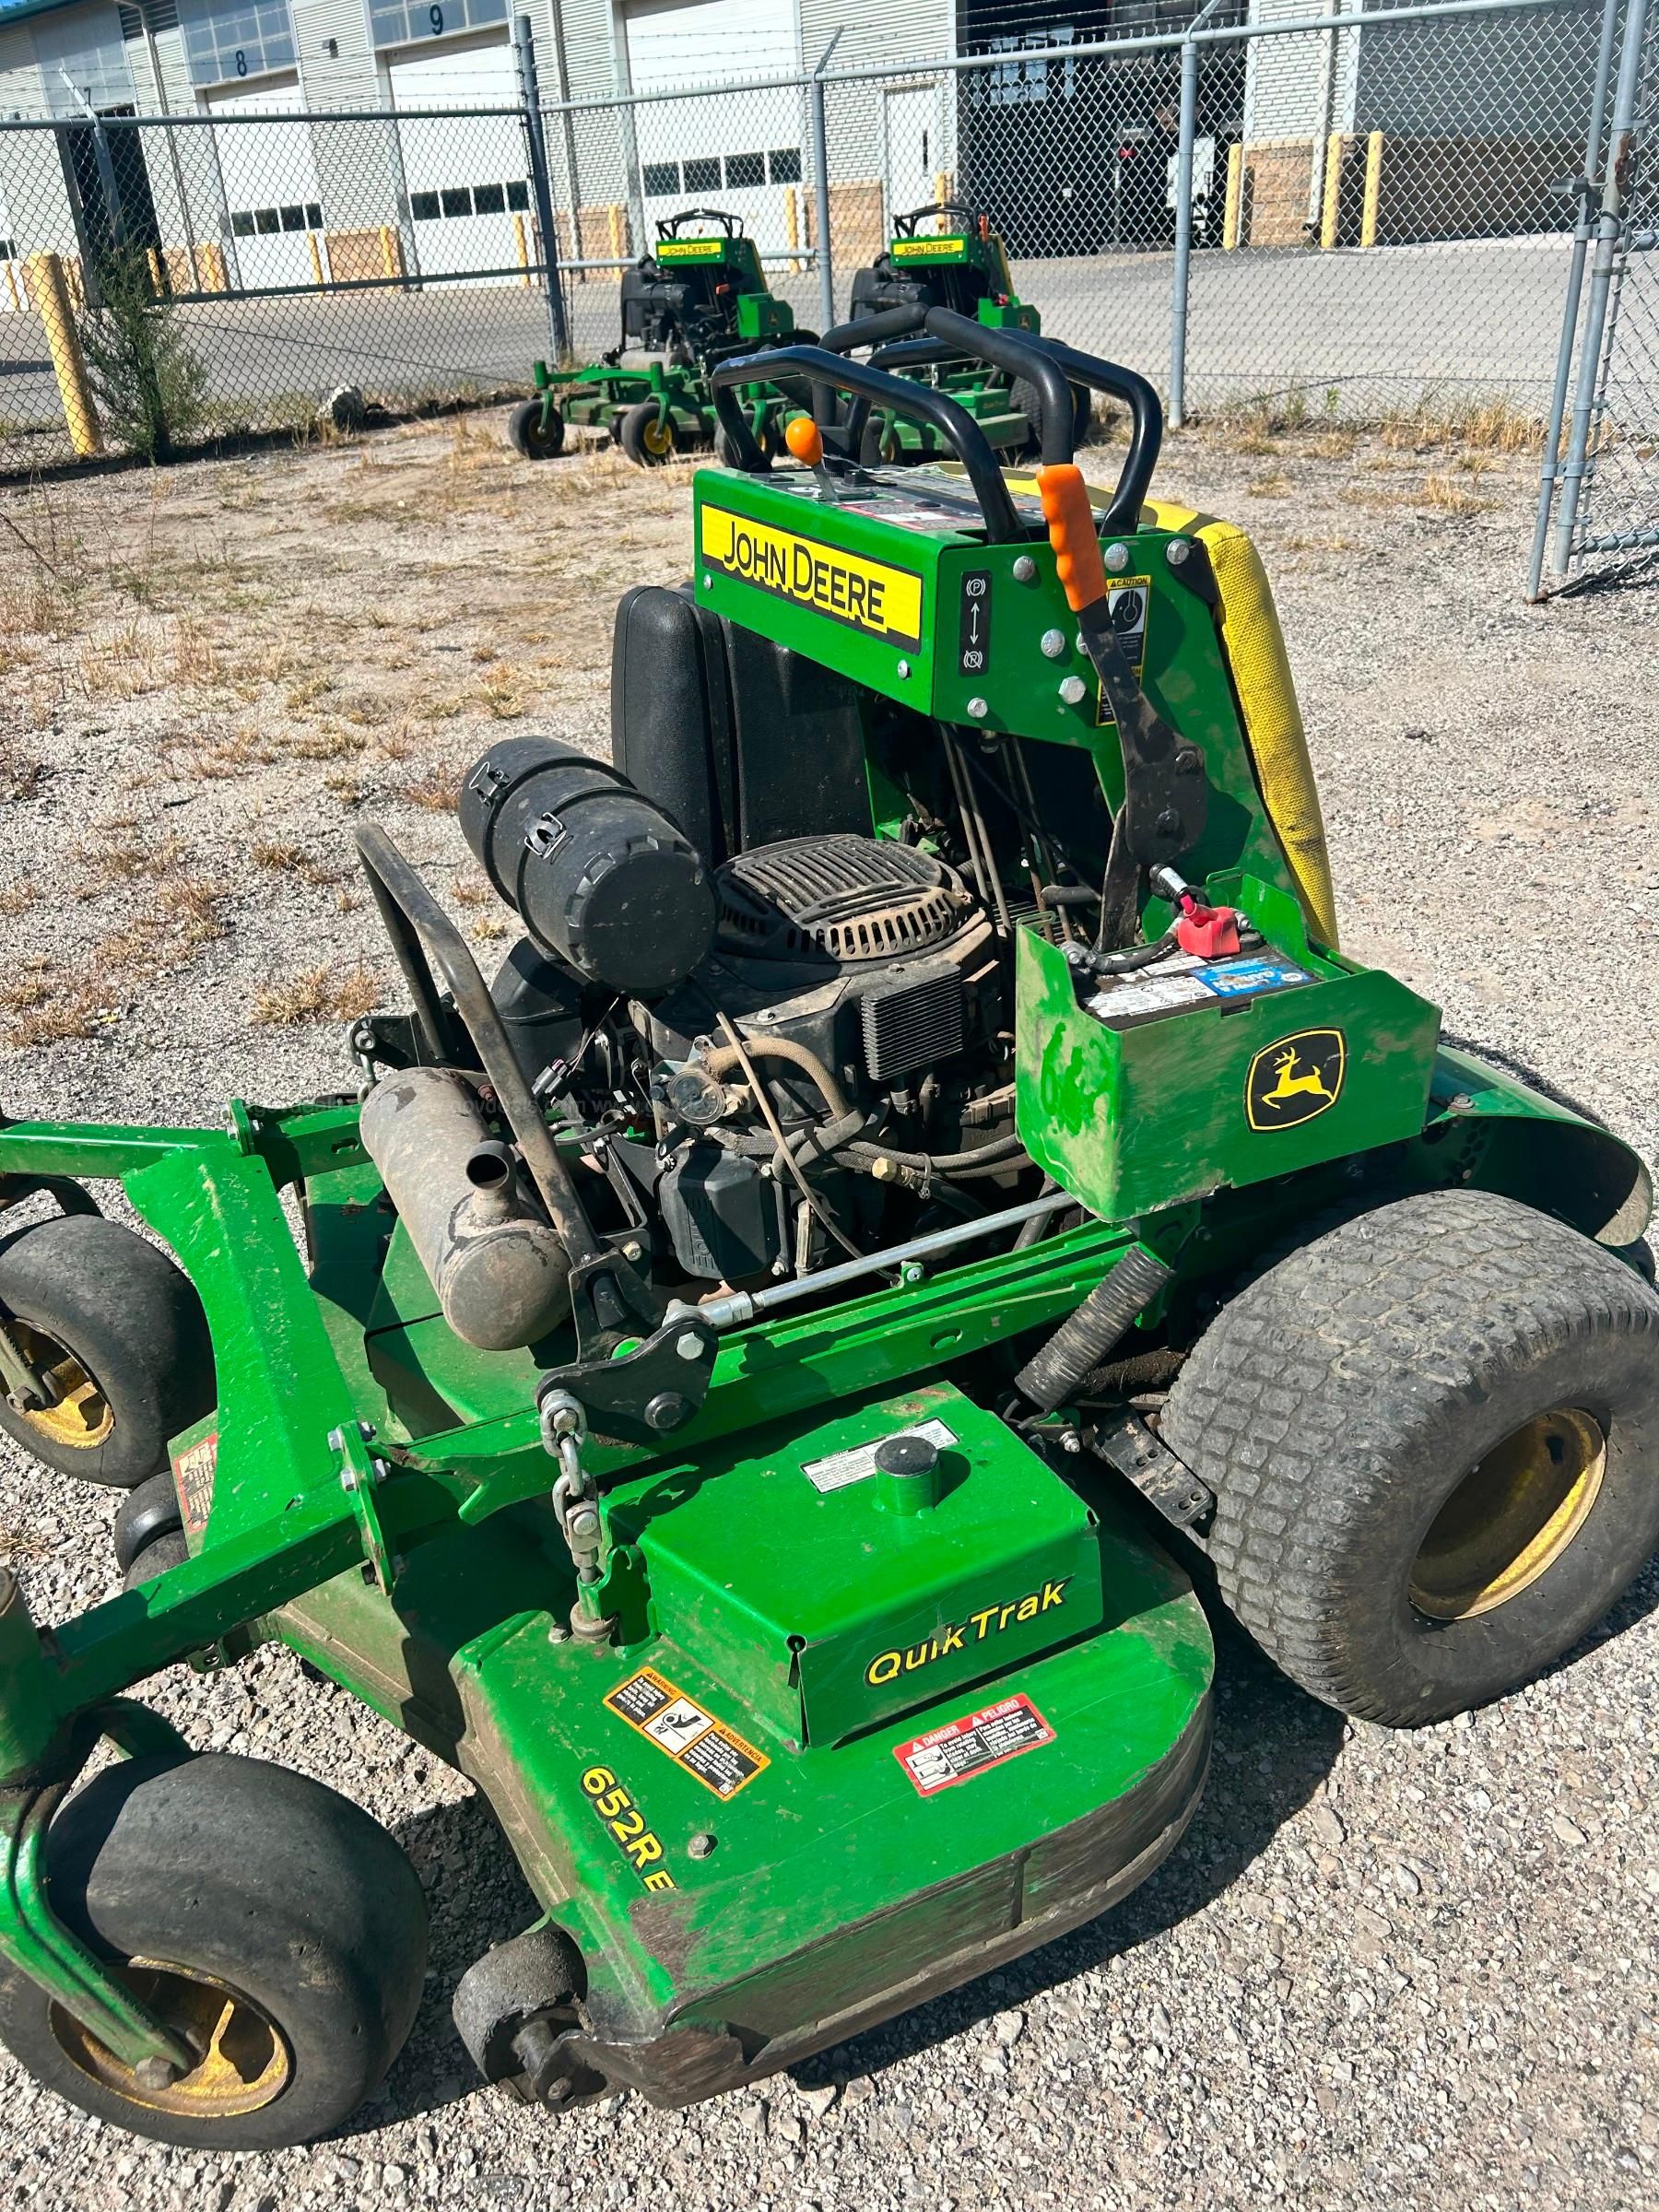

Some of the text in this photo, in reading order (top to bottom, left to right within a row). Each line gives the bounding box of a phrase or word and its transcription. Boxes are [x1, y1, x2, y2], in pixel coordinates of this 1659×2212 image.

[429, 4, 443, 35] 9
[236, 50, 248, 76] 8
[665, 244, 712, 255] JOHN DEERE
[901, 242, 954, 254] JOHN DEERE
[724, 521, 886, 626] JOHN DEERE
[1117, 577, 1147, 586] CAUTION
[652, 1673, 677, 1696] WARNING
[982, 1699, 1019, 1722] PELIGRO
[725, 1732, 762, 1763] ADVERTENCIA
[923, 1724, 959, 1748] DANGER
[582, 1767, 663, 1869] 652R
